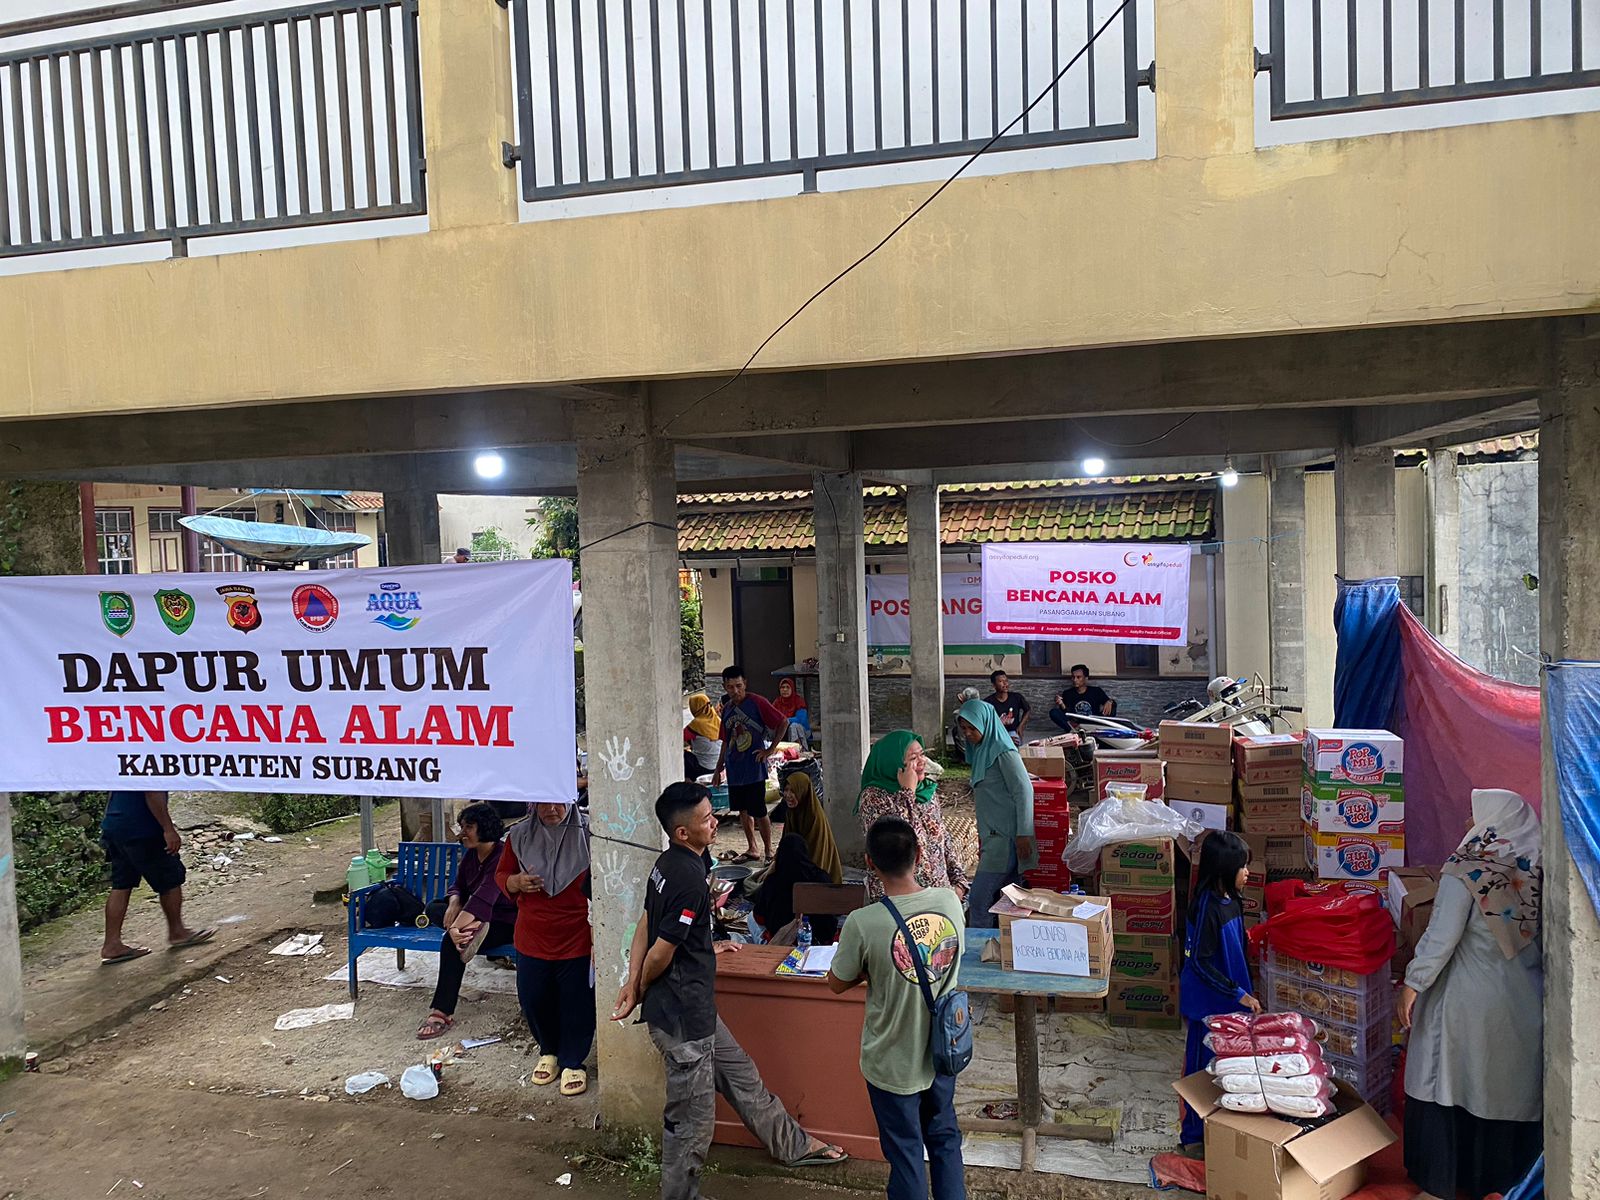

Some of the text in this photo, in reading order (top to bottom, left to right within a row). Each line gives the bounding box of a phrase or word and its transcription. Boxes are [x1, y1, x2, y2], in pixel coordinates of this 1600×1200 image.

[1050, 571, 1117, 584] POSKO
[366, 592, 422, 614] AQUA
[1007, 589, 1162, 606] BENCANA ALAM
[58, 647, 491, 693] DAPUR UMUM
[44, 704, 515, 747] BENCANA ALAM
[118, 754, 442, 783] KABUPATEN SUBANG
[1111, 849, 1164, 861] Sedaap
[1016, 944, 1046, 958] KORBAN
